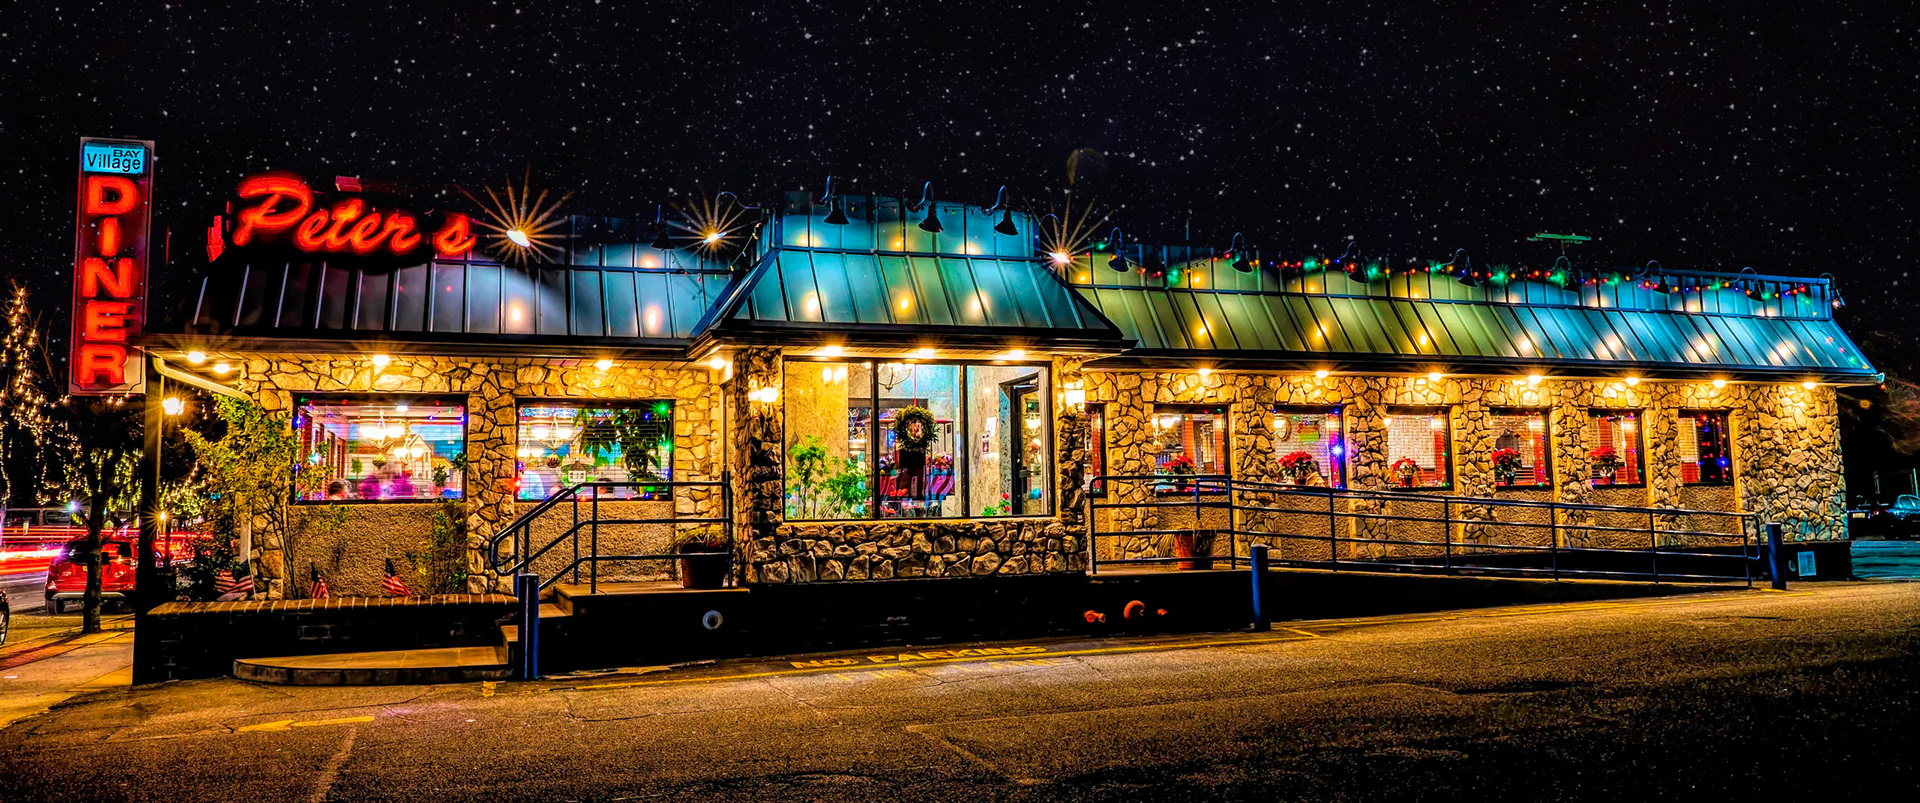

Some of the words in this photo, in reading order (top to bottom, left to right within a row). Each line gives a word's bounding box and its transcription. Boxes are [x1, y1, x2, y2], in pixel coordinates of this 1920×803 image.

[87, 153, 141, 173] Village
[113, 149, 141, 158] BAY
[232, 172, 477, 256] Peters
[79, 175, 138, 385] DINER
[790, 658, 859, 669] NO
[866, 645, 1047, 663] PARKING
